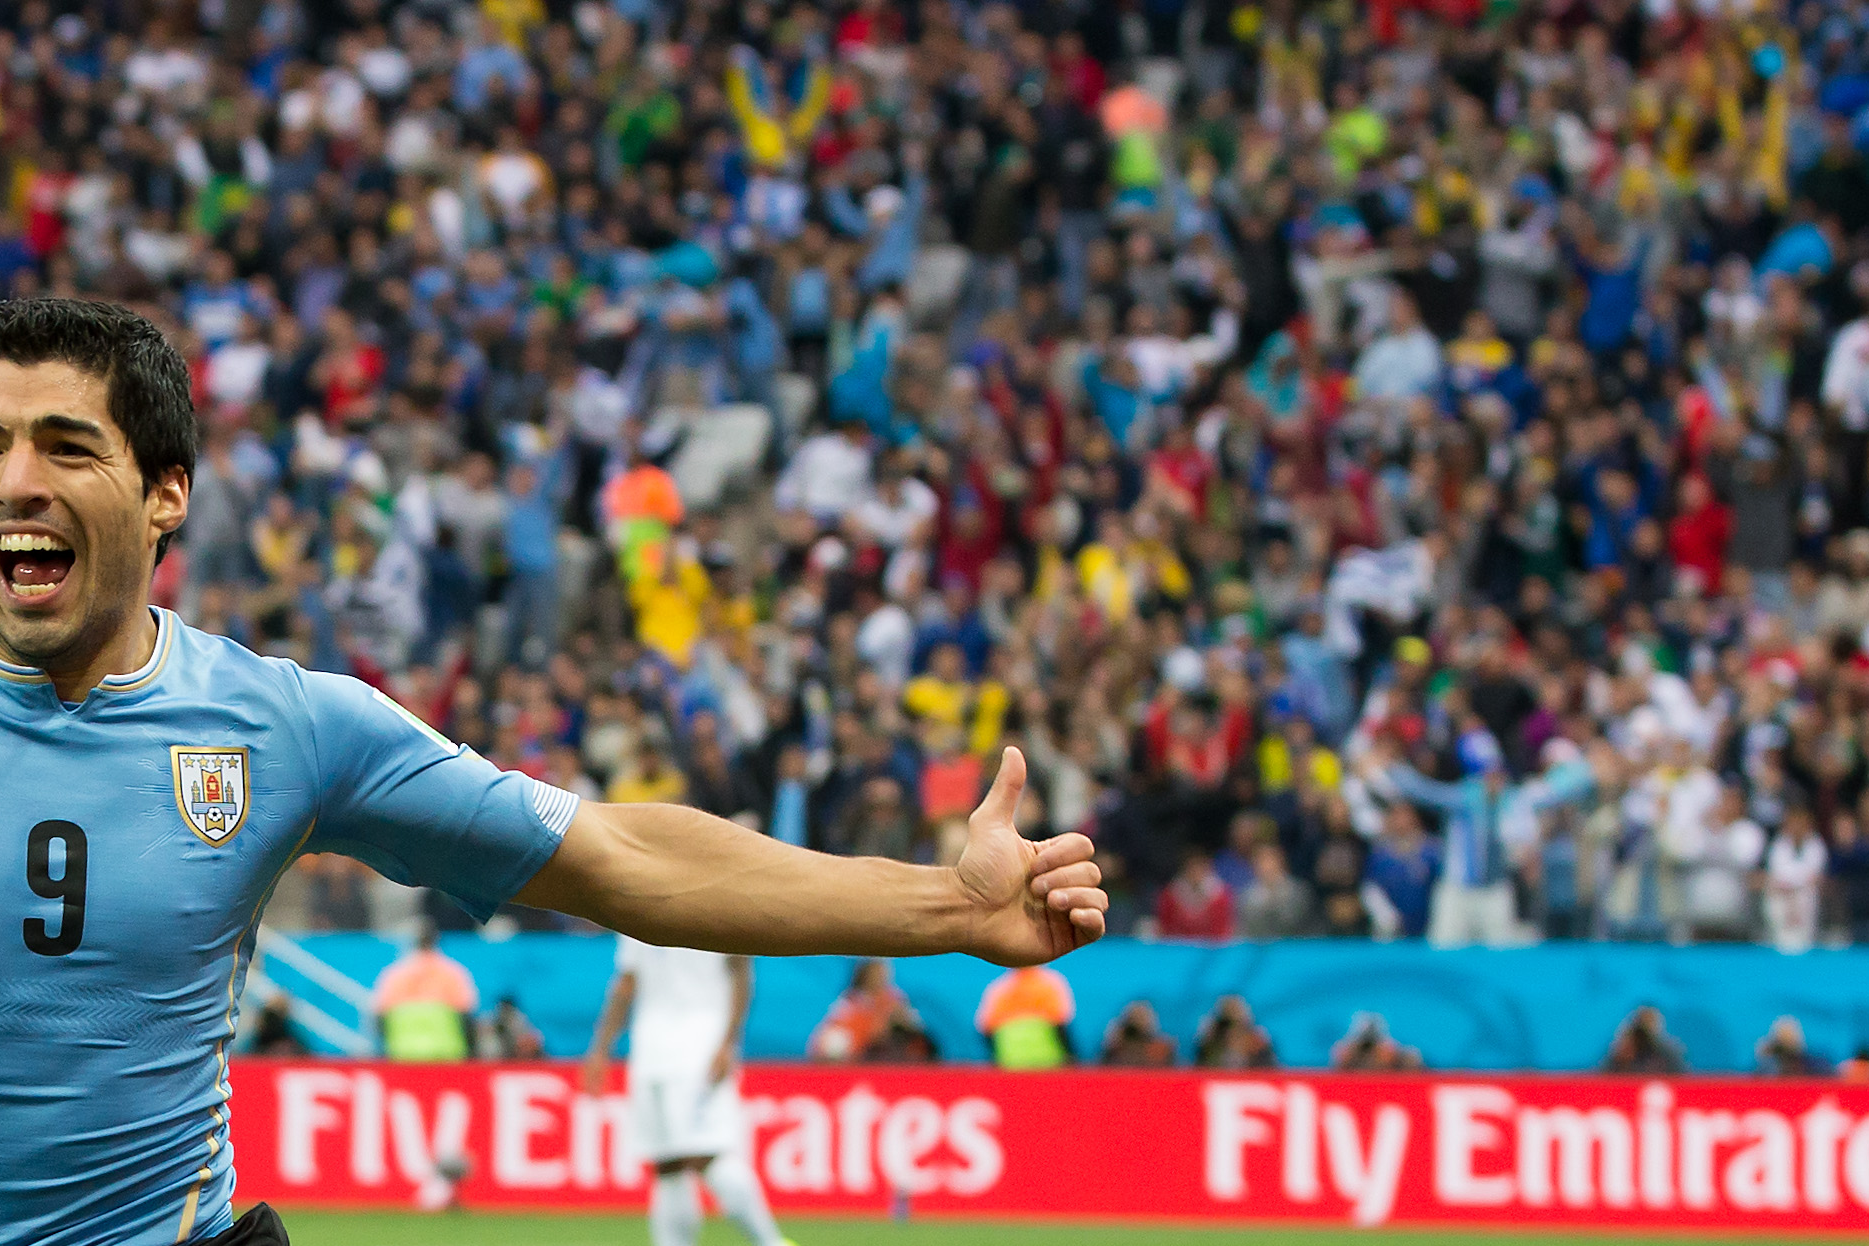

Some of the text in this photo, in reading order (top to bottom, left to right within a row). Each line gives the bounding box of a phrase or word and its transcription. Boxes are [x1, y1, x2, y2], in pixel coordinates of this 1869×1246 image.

[22, 819, 89, 957] 9
[276, 1068, 471, 1210] Fly
[1202, 1082, 1411, 1227] Fly
